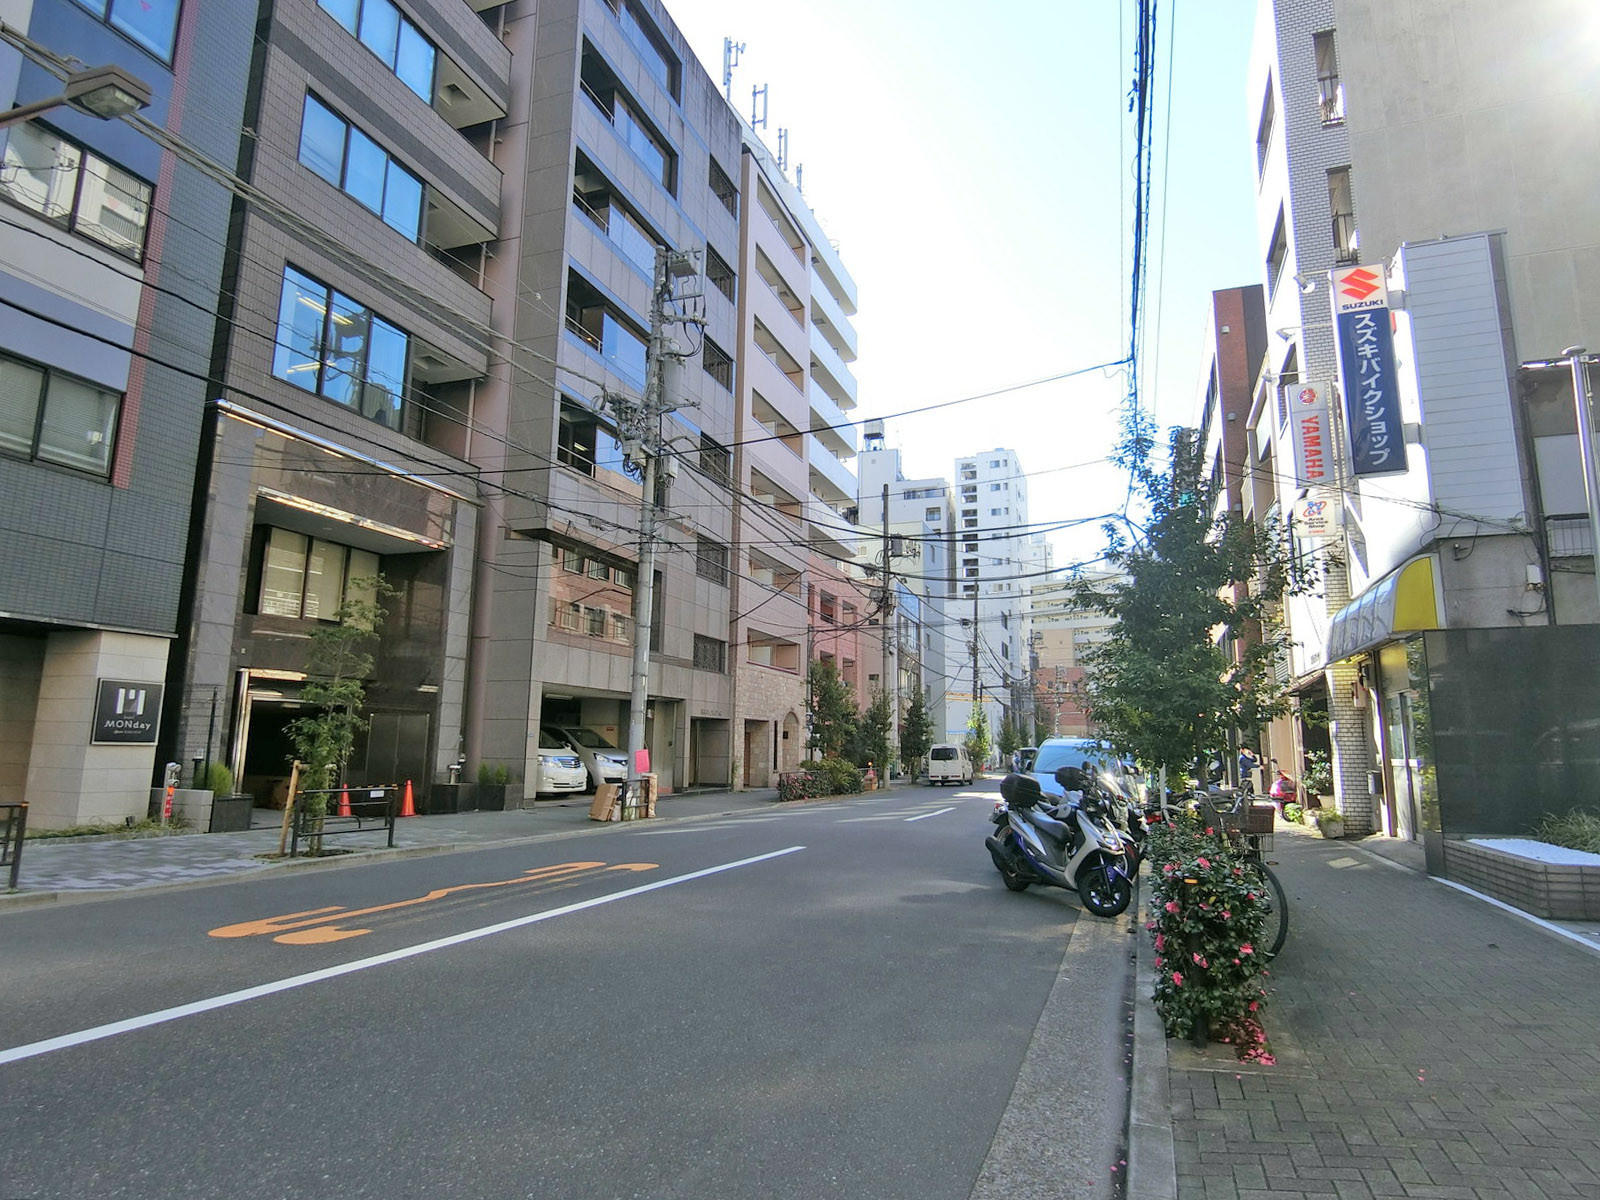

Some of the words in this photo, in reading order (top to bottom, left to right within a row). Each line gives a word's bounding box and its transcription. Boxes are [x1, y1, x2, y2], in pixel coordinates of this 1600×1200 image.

[1342, 299, 1384, 310] SUZUKI
[1354, 313, 1390, 465] スズキバイクショップ
[1301, 415, 1324, 479] YAMAHA
[104, 720, 151, 731] MONday
